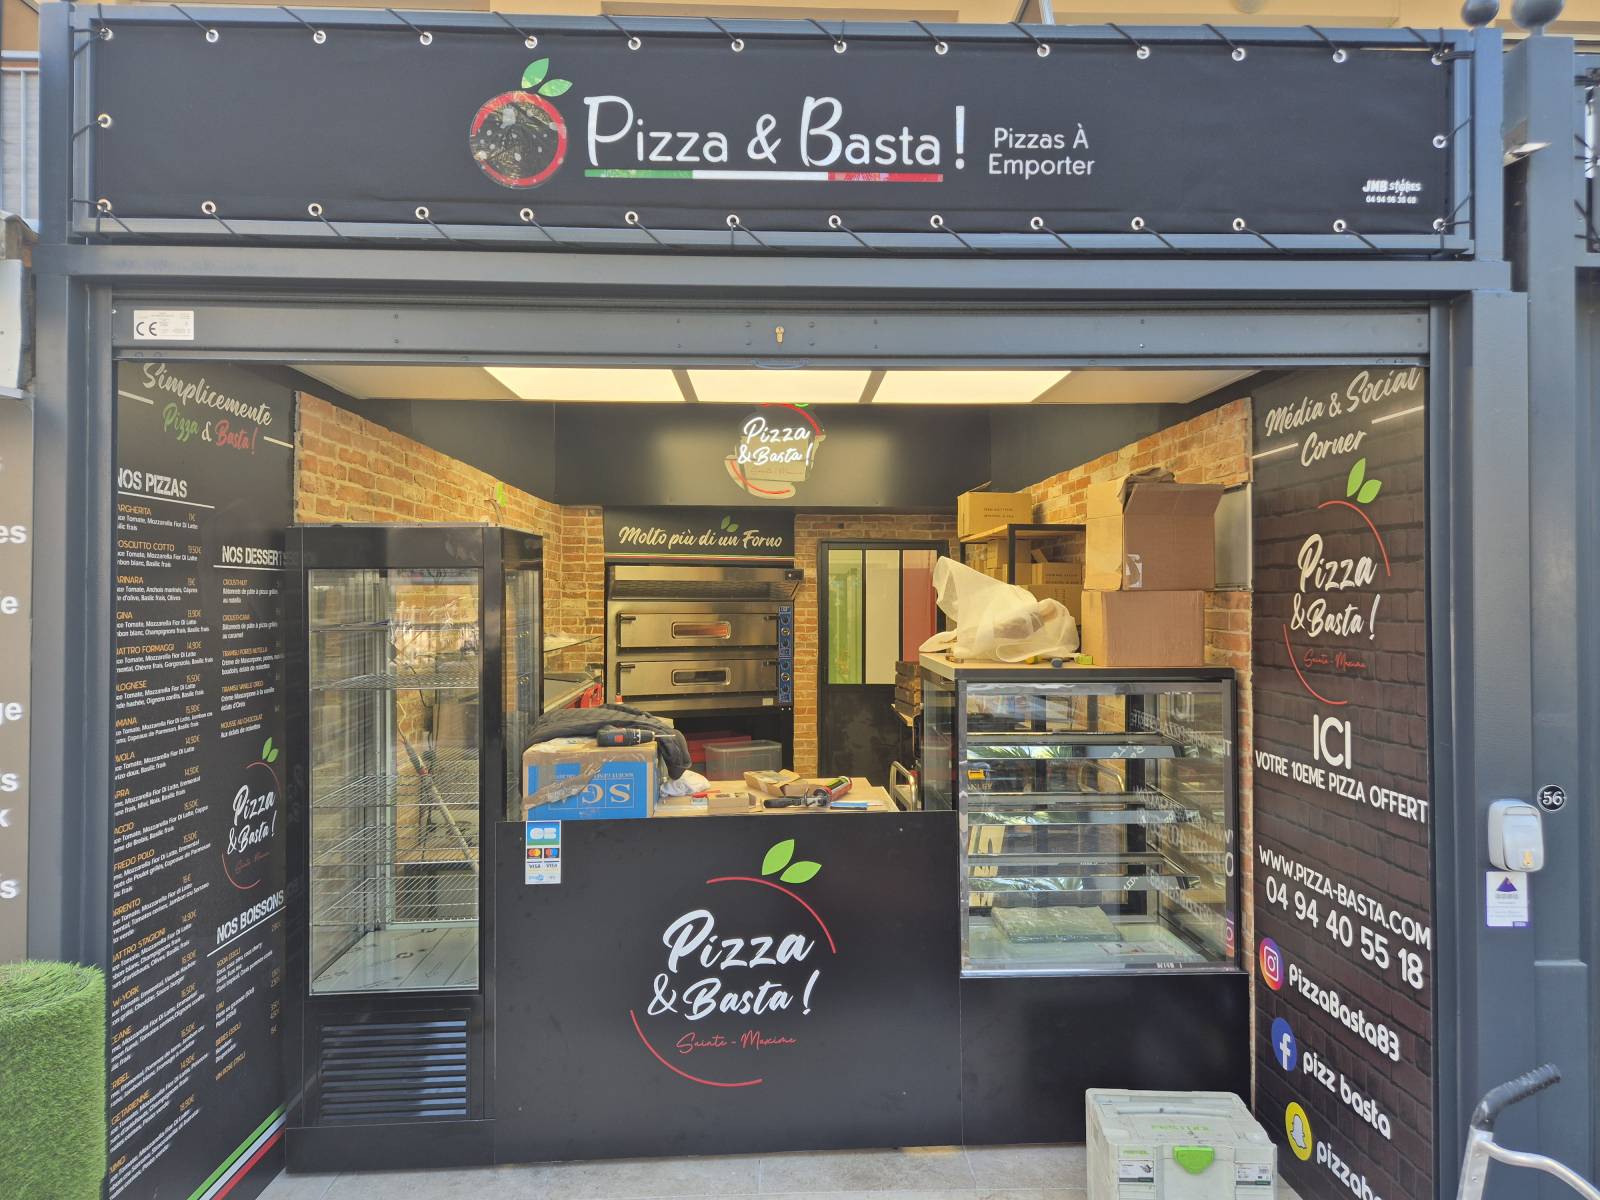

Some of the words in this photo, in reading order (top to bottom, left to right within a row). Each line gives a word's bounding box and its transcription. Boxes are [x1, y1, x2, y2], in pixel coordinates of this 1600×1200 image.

[583, 95, 728, 166] Pizza
[747, 113, 781, 164] &
[994, 126, 1064, 149] Pizzas
[1073, 123, 1089, 149] À
[989, 154, 1094, 179] Emporter
[1362, 180, 1388, 192] JMB
[142, 362, 273, 426] Simplicemente
[1265, 396, 1326, 436] Média
[1329, 392, 1342, 417] &
[1346, 366, 1421, 412] Social
[163, 402, 199, 442] Pizza
[201, 420, 212, 442] &
[743, 416, 810, 444] Pizza
[1301, 430, 1367, 467] Corner
[145, 472, 187, 498] PIZZAS
[222, 545, 242, 563] NOS
[618, 526, 668, 546] Molto
[668, 529, 697, 550] più
[699, 529, 717, 546] di
[718, 536, 740, 546] un
[743, 529, 783, 548] Forno
[1297, 533, 1377, 593] Pizza
[1290, 592, 1306, 630] &
[1313, 714, 1352, 770] ICI
[233, 784, 276, 826] Pizza
[1255, 750, 1289, 777] VOTRE
[1291, 761, 1326, 790] 10EME
[1328, 772, 1366, 804] PIZZA
[1369, 785, 1428, 823] OFFERT
[1542, 791, 1563, 806] 56
[137, 848, 154, 861] POLO
[227, 827, 237, 856] &
[216, 915, 237, 944] NOS
[240, 888, 283, 930] BOISSONS
[1258, 844, 1431, 951] WWW.PIZZA-BASTA.COM
[662, 909, 815, 974] Pizza
[1266, 876, 1289, 910] 04
[1294, 891, 1319, 928] 94
[1325, 909, 1353, 947] 40
[1360, 926, 1390, 969] 55
[1397, 948, 1424, 990] 18
[647, 973, 678, 1016] &
[682, 977, 793, 1021] Basta
[676, 1032, 728, 1054] Sainte
[740, 1030, 797, 1050] Maxime
[1303, 1051, 1337, 1093] pizz
[1340, 1073, 1391, 1140] basta
